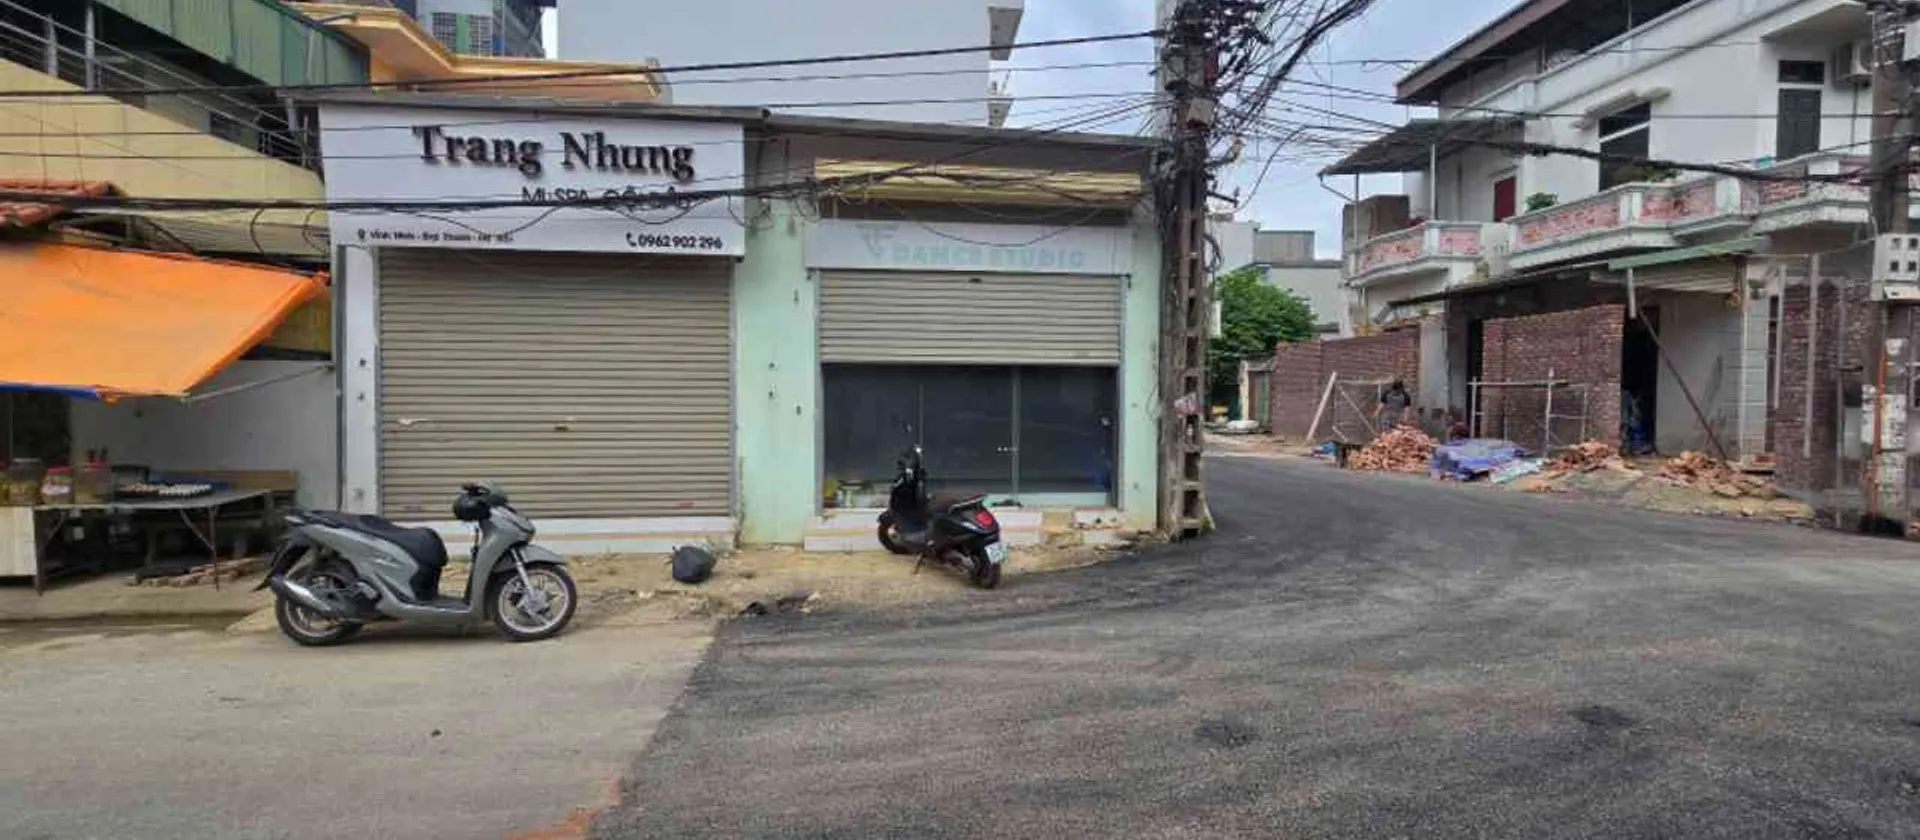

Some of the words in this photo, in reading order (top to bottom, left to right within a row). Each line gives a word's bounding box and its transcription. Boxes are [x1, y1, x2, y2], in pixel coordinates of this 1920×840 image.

[411, 125, 544, 178] Trang
[559, 131, 696, 182] Nhung
[637, 233, 671, 248] 0962
[672, 235, 696, 248] 902
